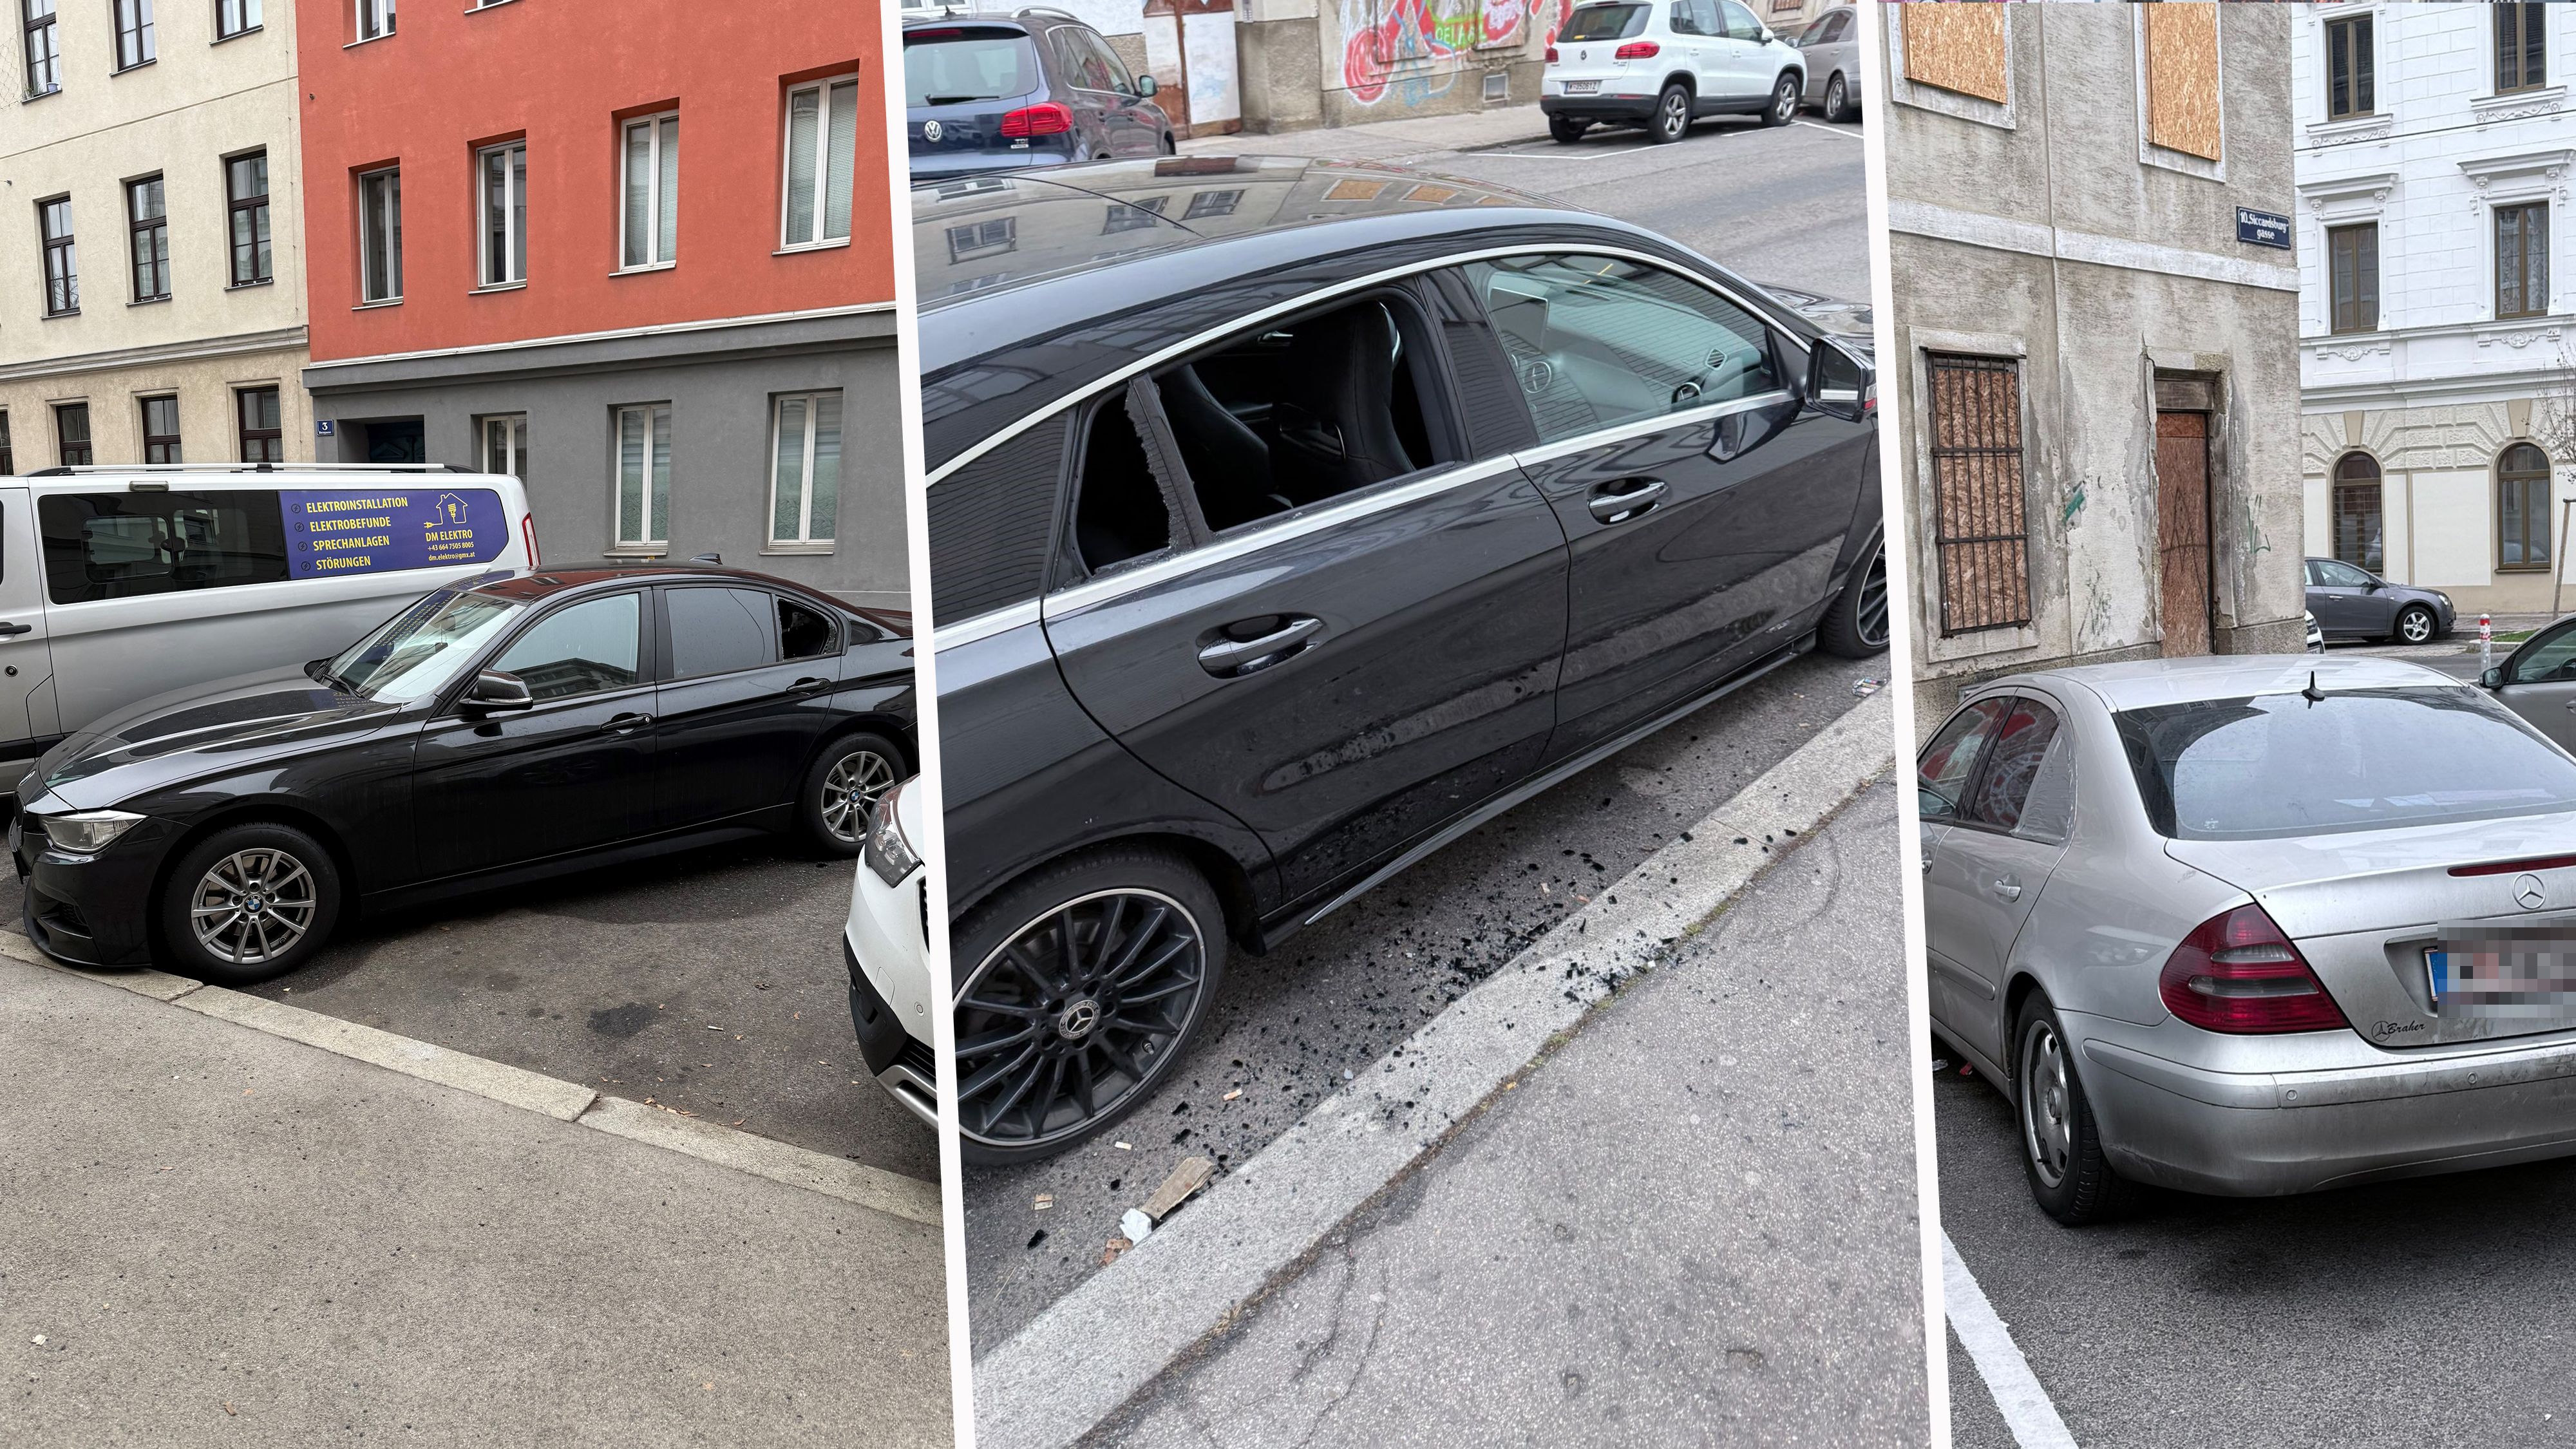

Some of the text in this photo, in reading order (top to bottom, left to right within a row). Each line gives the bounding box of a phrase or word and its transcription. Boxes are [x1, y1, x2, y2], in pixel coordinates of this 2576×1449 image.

[2257, 229, 2275, 240] gasse
[322, 422, 328, 431] 3
[306, 497, 408, 513] ELEKTROINSTALLATION
[310, 516, 392, 532] ELEKTROBEFUNDE
[425, 529, 473, 542] DM ELEKTRO
[313, 535, 390, 551] SPRECHANLAGEN
[316, 556, 372, 571] STÖRUNGEN
[428, 552, 475, 561] dm.elektro@gmx.at
